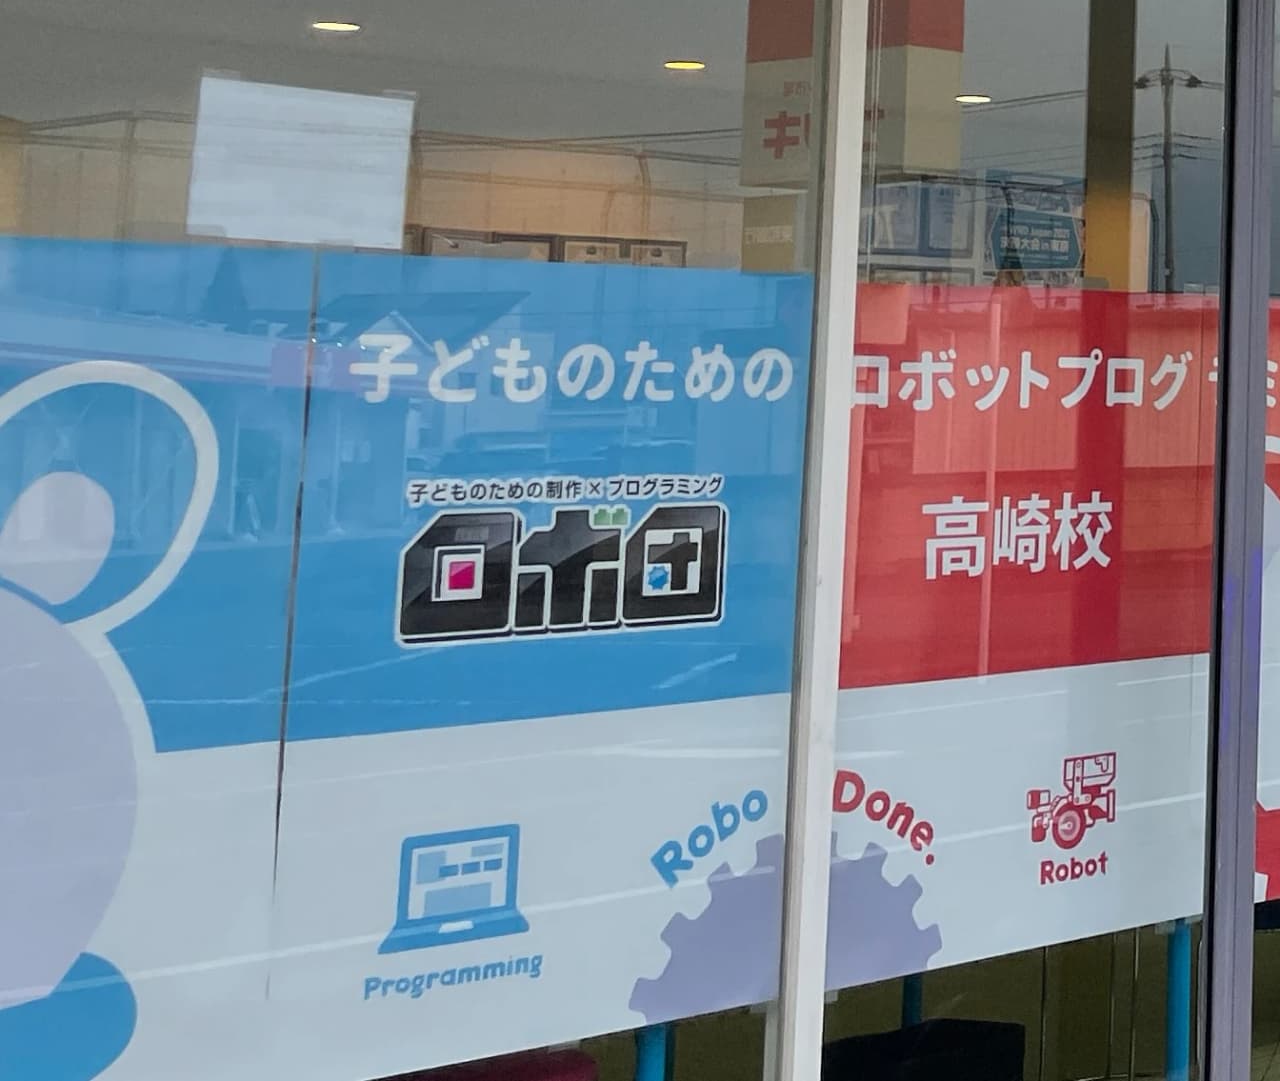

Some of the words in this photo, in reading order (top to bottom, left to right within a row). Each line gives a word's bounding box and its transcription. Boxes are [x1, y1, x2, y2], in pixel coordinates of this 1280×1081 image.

[350, 333, 794, 404] 子どものための
[922, 490, 1113, 580] 高崎校
[650, 789, 769, 888] Robo
[1040, 851, 1109, 885] Robot
[363, 954, 544, 1001] Programming
